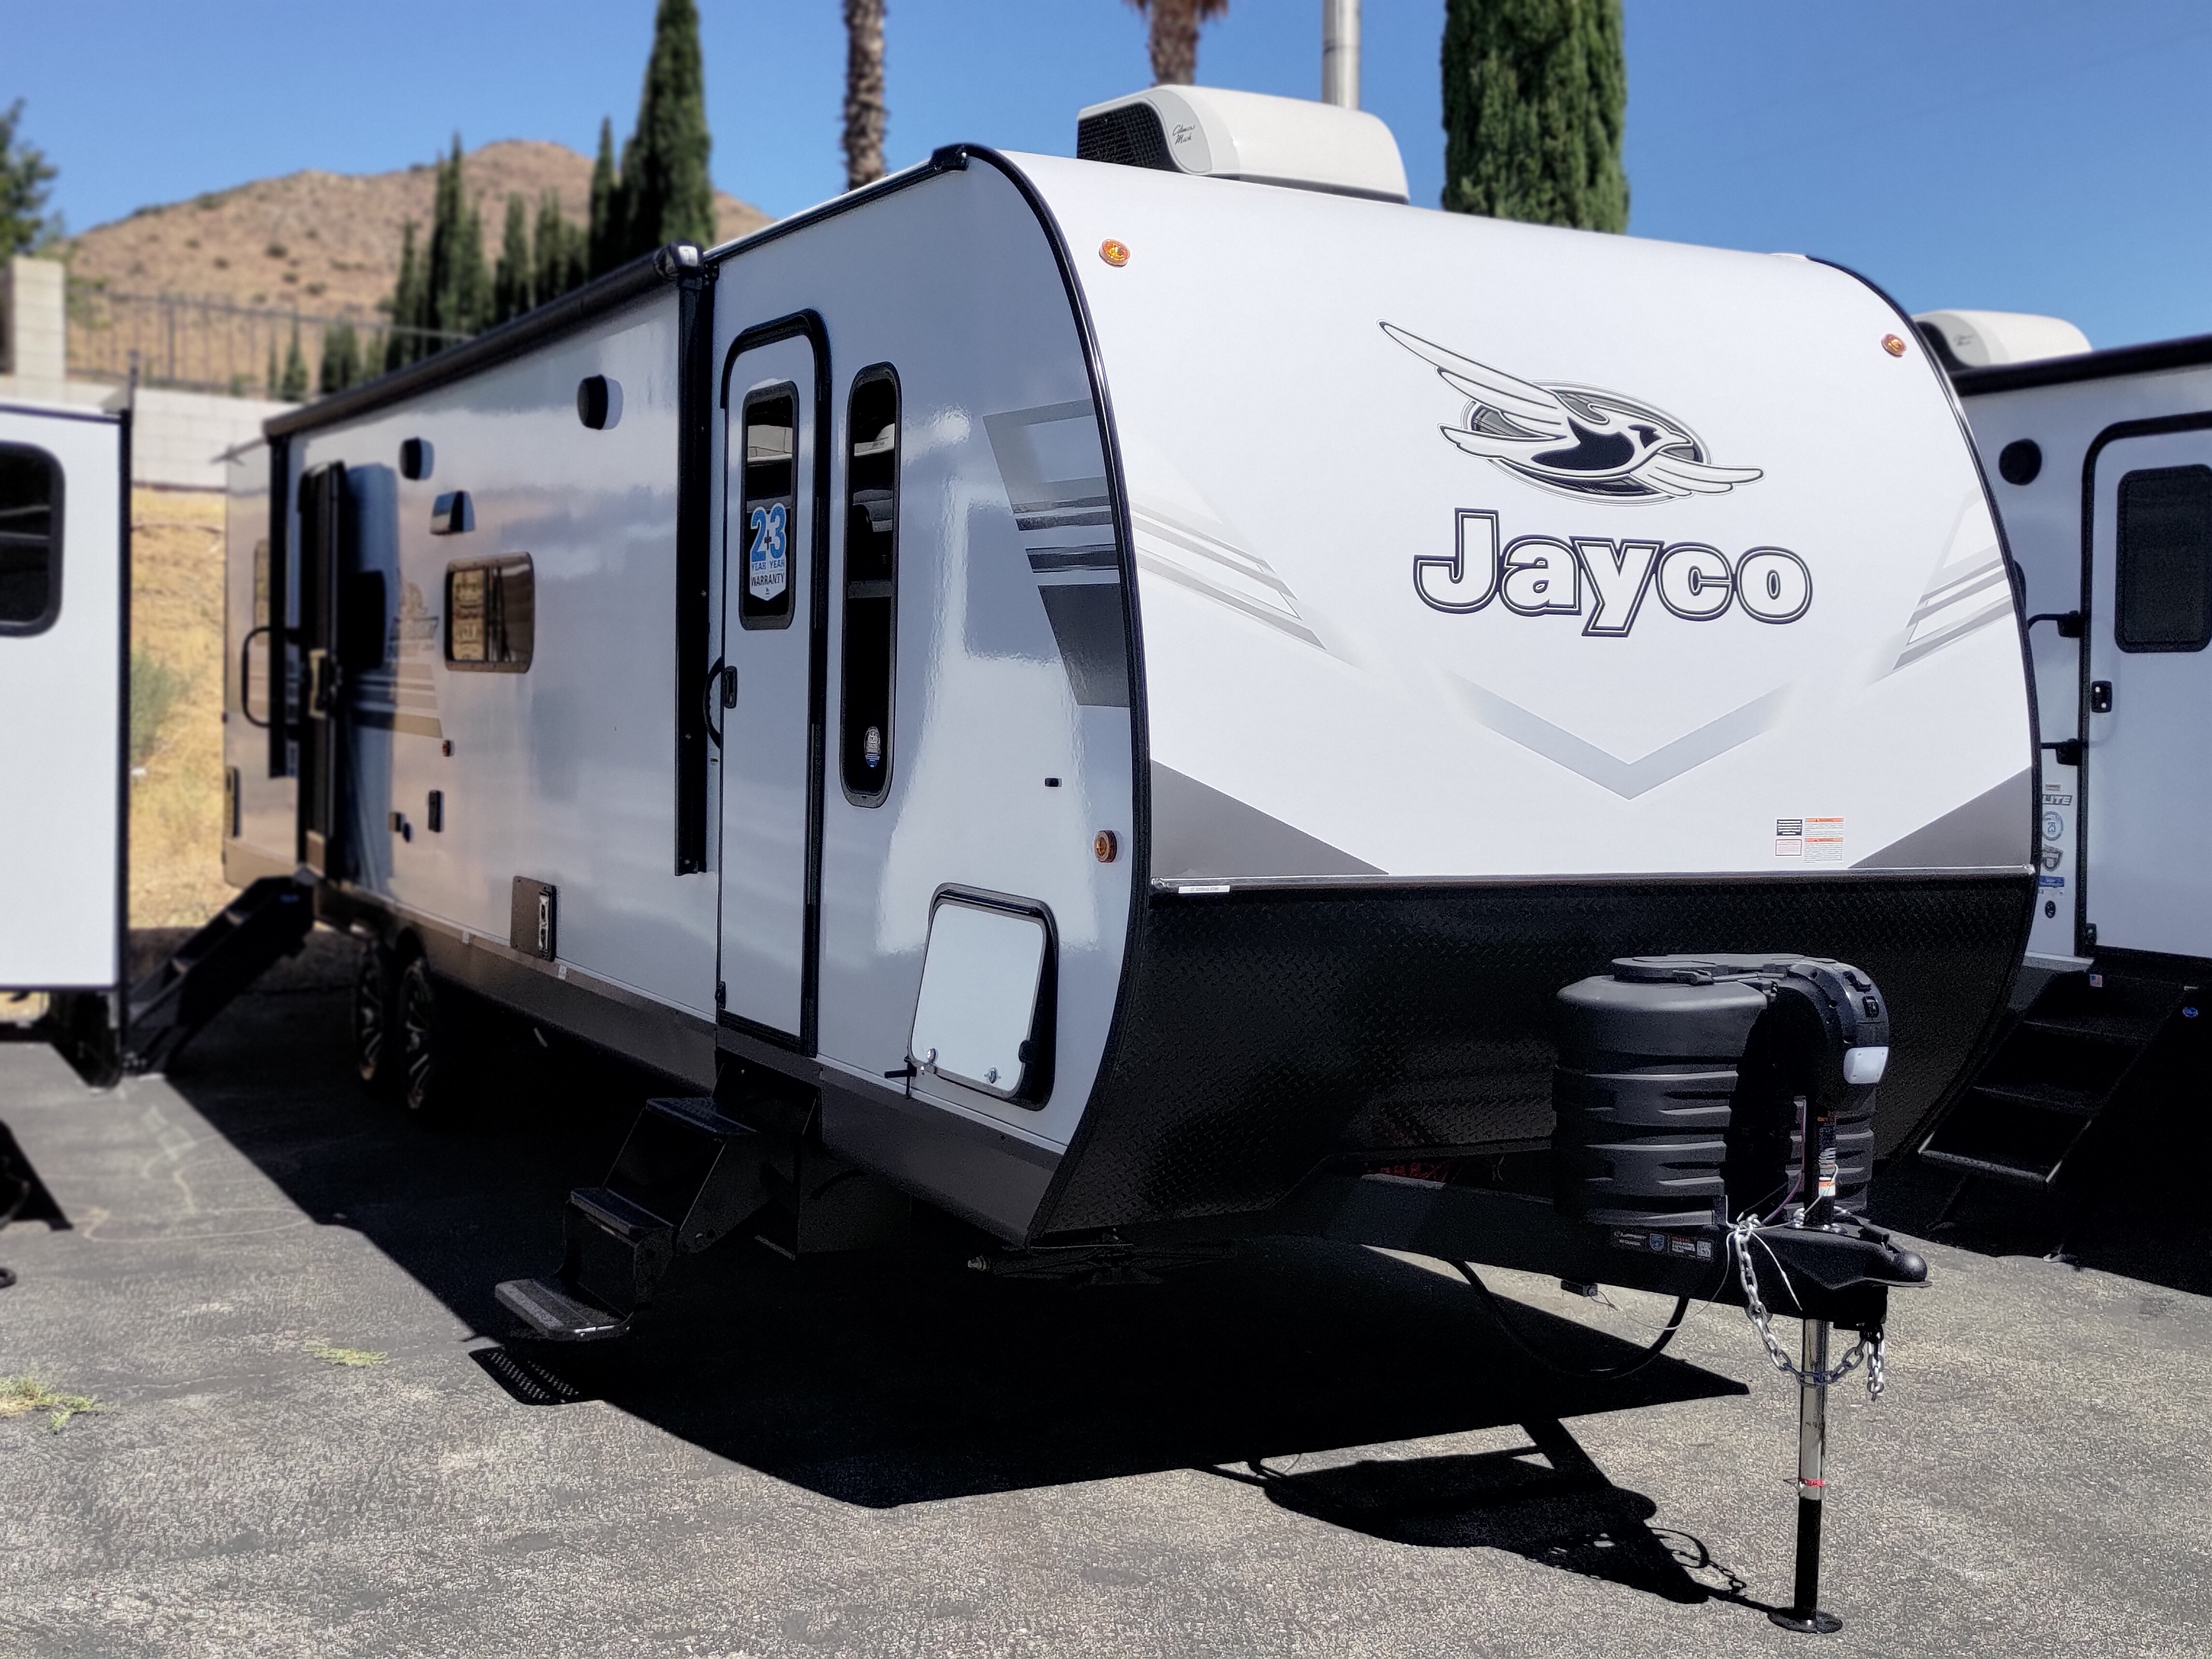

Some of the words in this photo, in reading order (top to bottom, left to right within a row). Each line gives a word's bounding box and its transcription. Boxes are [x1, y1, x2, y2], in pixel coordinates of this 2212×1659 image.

[751, 562, 766, 571] YEAR
[770, 559, 785, 569] YEAR
[1414, 507, 1813, 638] Jayco
[751, 572, 785, 587] WARRANTY
